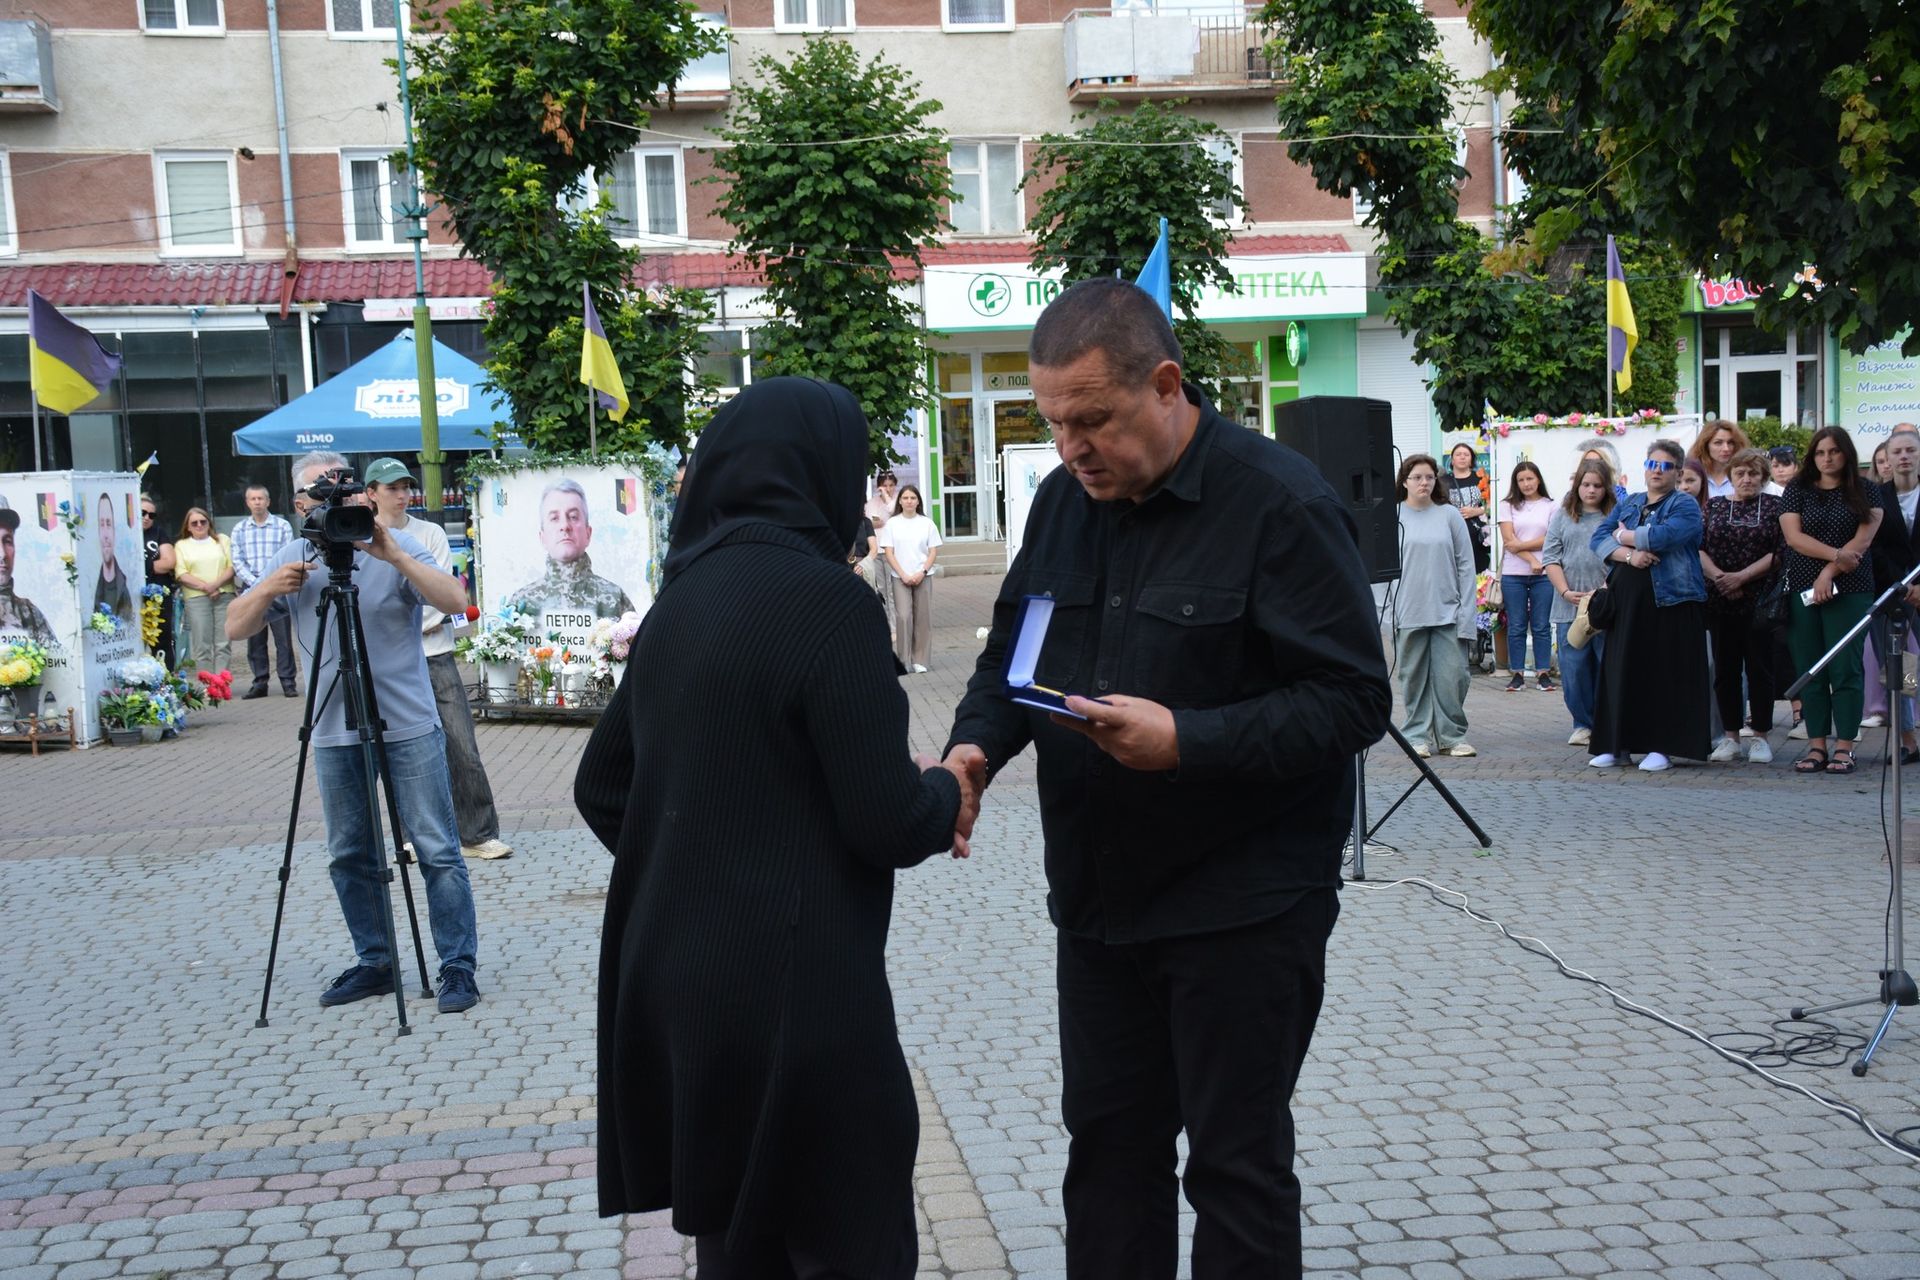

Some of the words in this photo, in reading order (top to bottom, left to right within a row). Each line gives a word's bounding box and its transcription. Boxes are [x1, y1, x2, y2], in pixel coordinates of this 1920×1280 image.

[1857, 360, 1916, 373] Візочки
[1857, 379, 1915, 392] Манежі
[546, 614, 592, 628] ПЕТРОВ
